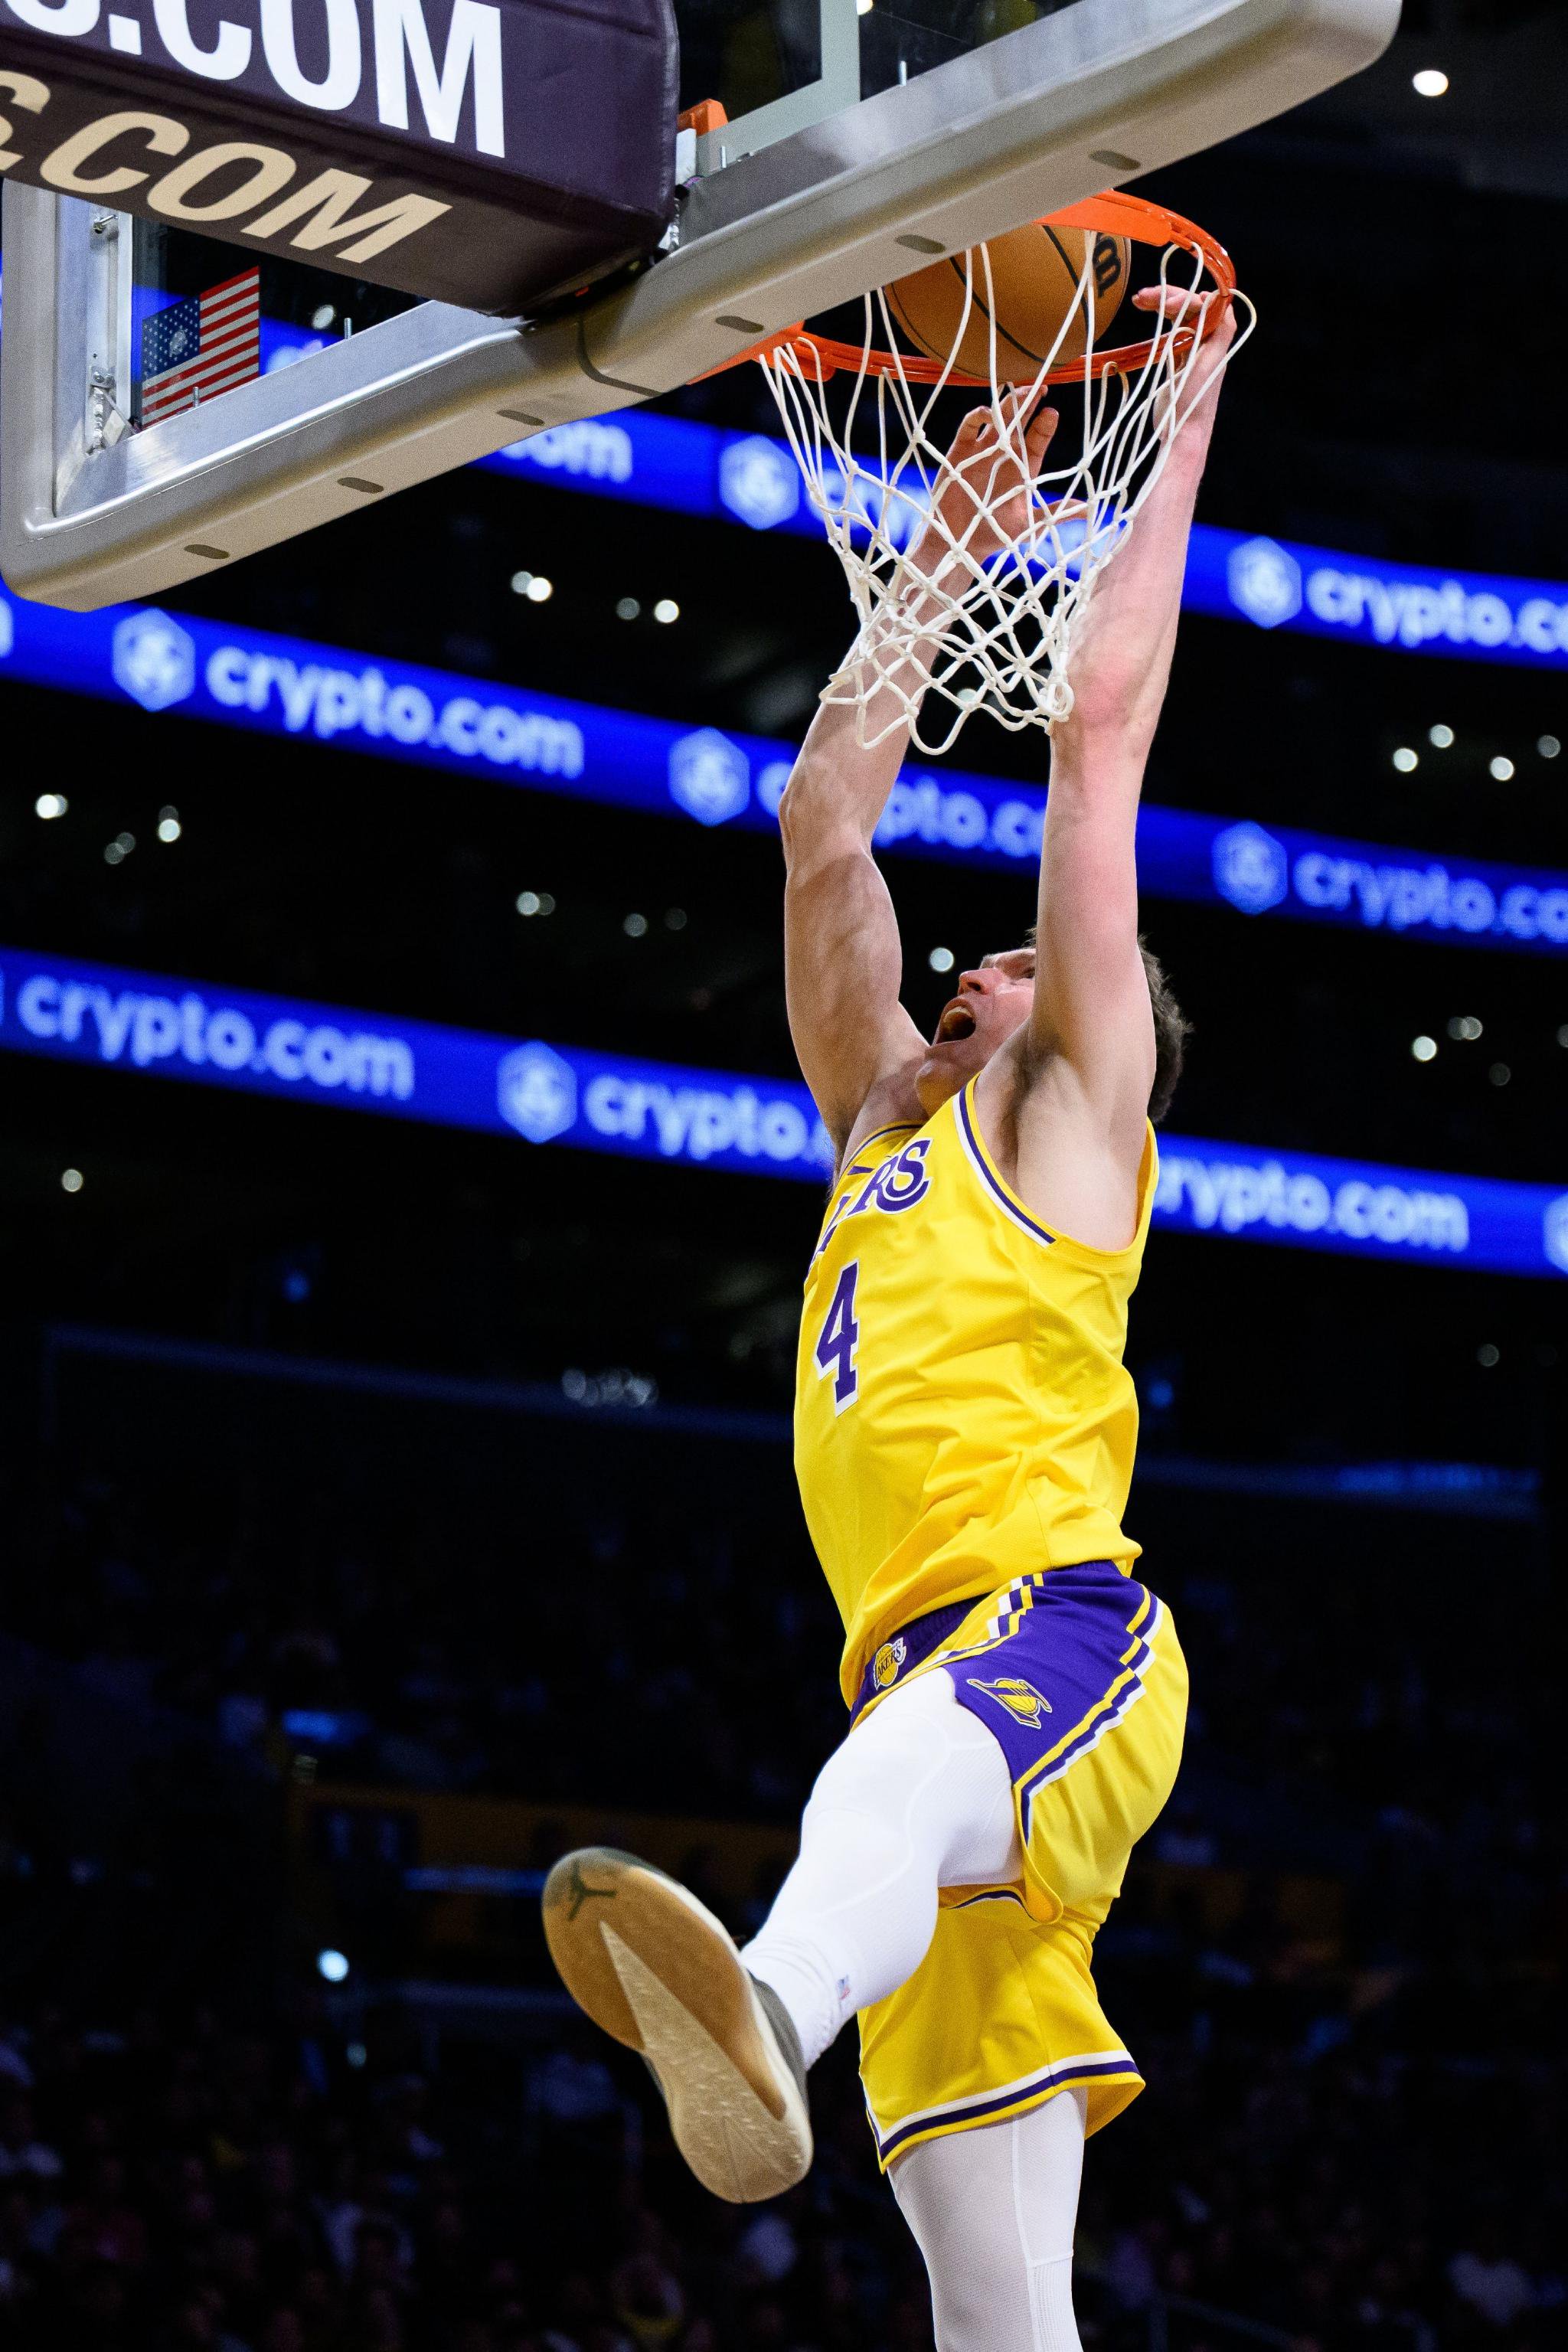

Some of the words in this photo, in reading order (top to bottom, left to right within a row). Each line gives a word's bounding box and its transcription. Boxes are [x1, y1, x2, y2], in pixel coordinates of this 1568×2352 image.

[1306, 567, 1568, 653] crypto.c
[206, 646, 584, 779] crypto.com
[17, 974, 415, 1101] crypto.com
[1152, 1157, 1468, 1253] rypto.com
[814, 1260, 860, 1417] 4
